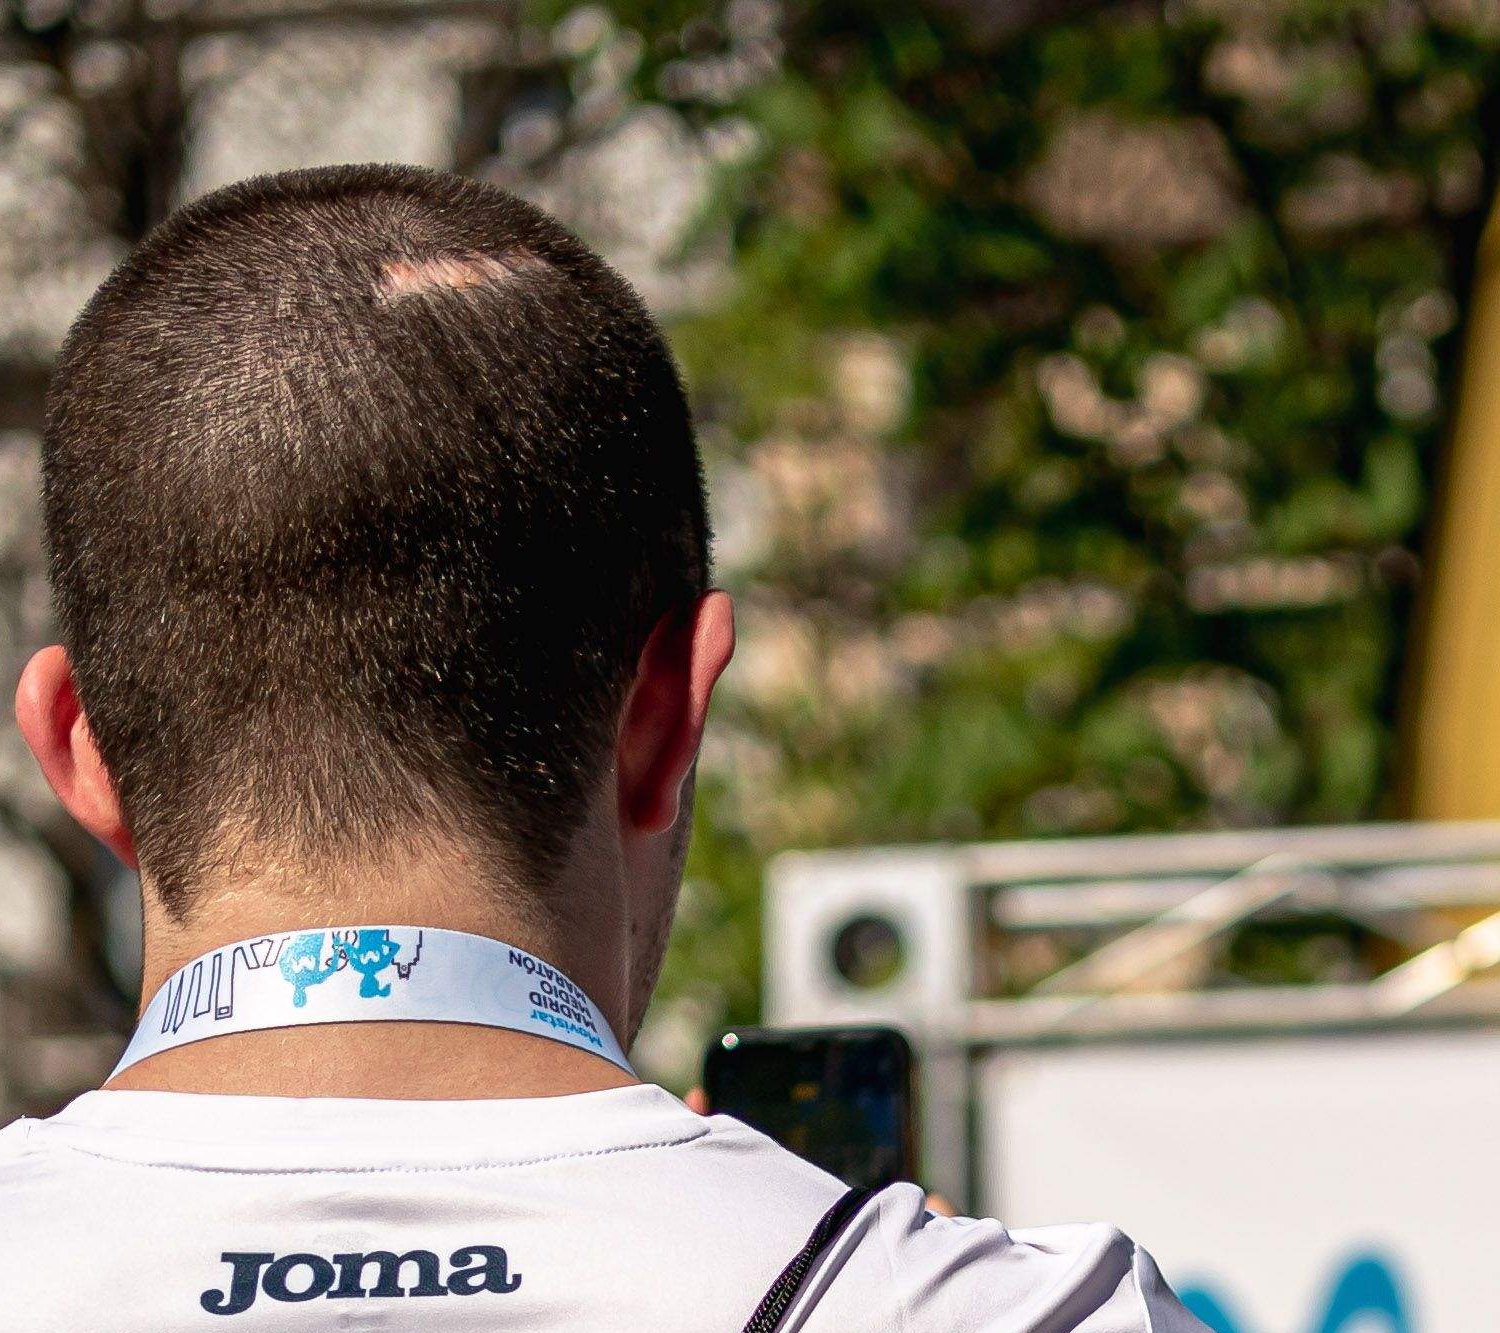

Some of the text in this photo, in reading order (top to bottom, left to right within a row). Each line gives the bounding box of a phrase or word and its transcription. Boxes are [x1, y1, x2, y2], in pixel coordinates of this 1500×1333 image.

[509, 950, 587, 1003] MARATÓN
[529, 992, 598, 1034] MADRID
[540, 980, 592, 1019] MEDIO
[530, 1009, 603, 1048] Movistar
